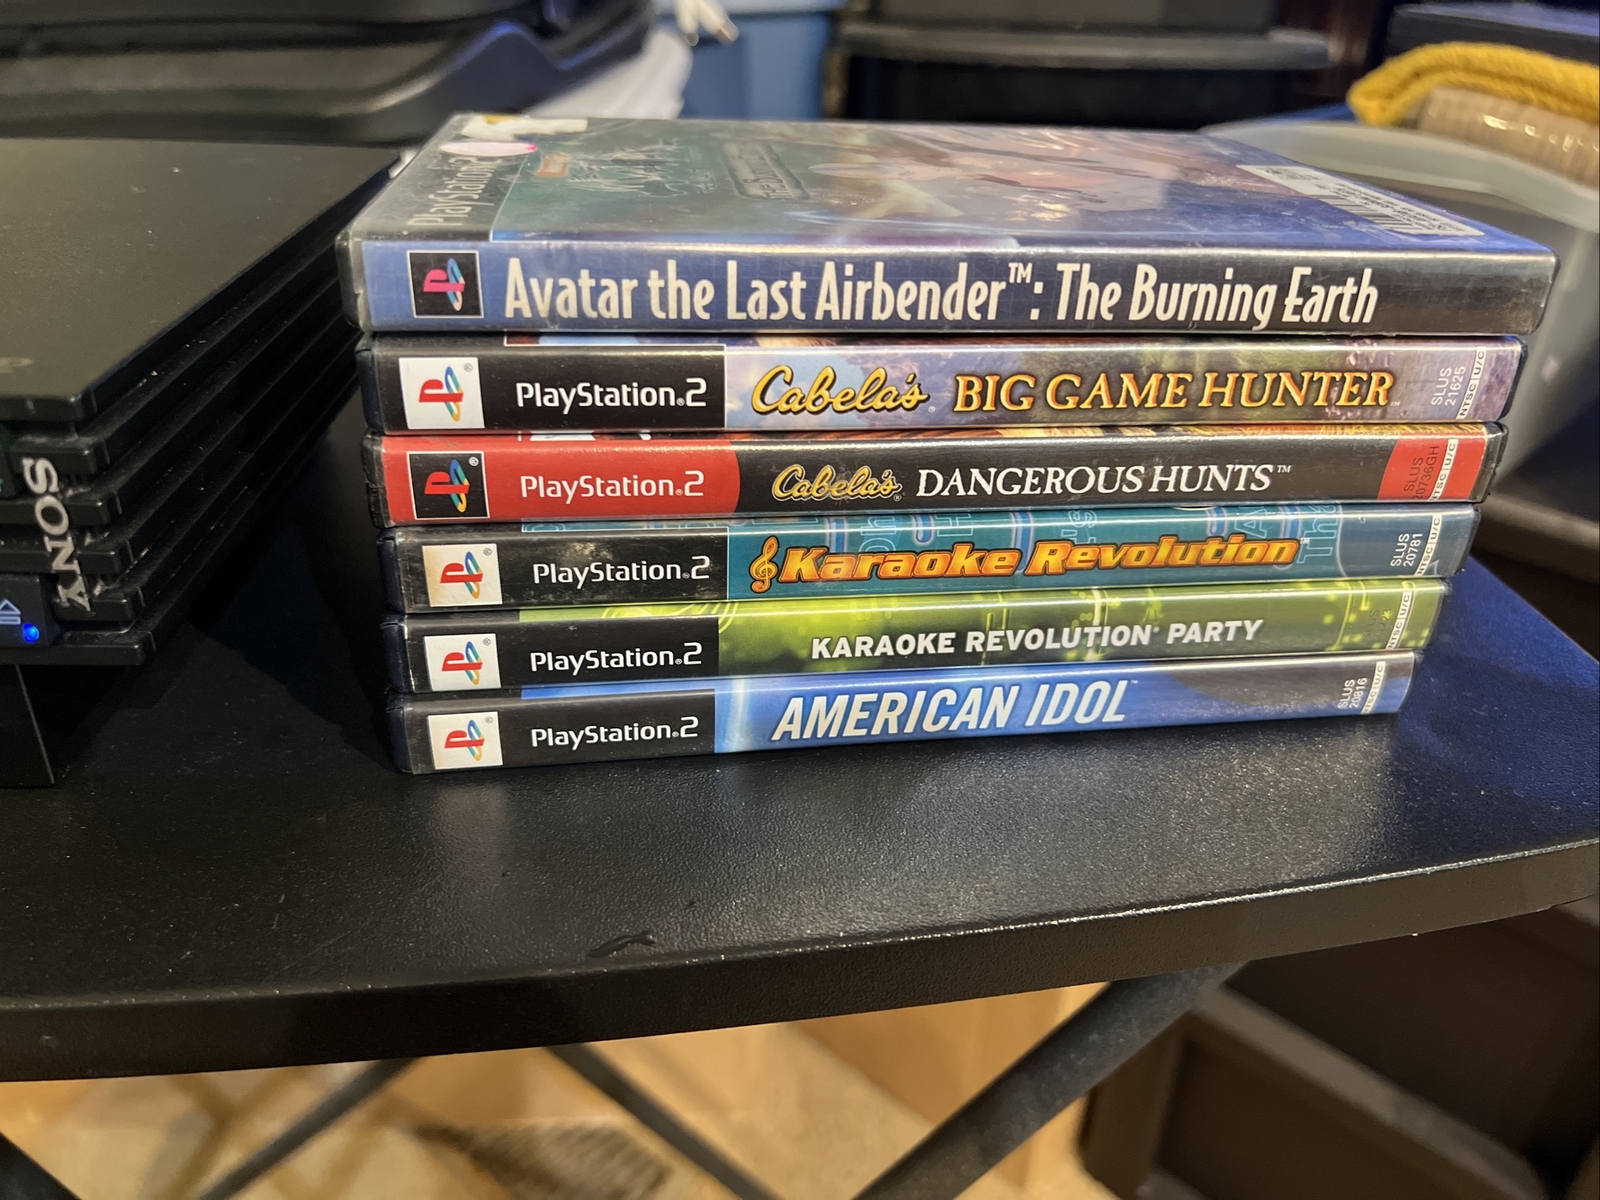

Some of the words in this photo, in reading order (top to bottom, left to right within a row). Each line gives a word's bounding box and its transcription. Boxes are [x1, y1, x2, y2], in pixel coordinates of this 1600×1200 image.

[505, 256, 638, 320] Avatar
[647, 259, 715, 320] the
[727, 259, 807, 321] Last
[1057, 263, 1122, 322] The
[1129, 265, 1278, 330] Burning
[1283, 267, 1379, 325] Earth
[752, 364, 929, 414] Cabela's
[953, 373, 1035, 413] BIG
[1046, 372, 1192, 411] GAME
[1431, 367, 1452, 406] SLUS
[1444, 366, 1467, 406] 21625
[1459, 383, 1477, 416] NTSC
[916, 464, 1147, 497] DANGEROUS
[1404, 457, 1424, 492] SLUS
[22, 456, 91, 613] SONY
[1390, 533, 1410, 567] SLUS
[1403, 533, 1423, 567] 20781
[778, 541, 1022, 584] Karaoke
[1416, 546, 1433, 575] NTSC
[812, 632, 957, 660] KARAOKE
[964, 624, 1159, 653] REVOLUTION
[1167, 619, 1264, 646] PARTY
[1388, 622, 1402, 648] NTSC
[1337, 679, 1356, 709] SLUS
[1349, 677, 1368, 709] 20816
[771, 684, 1019, 742] AMERICAN
